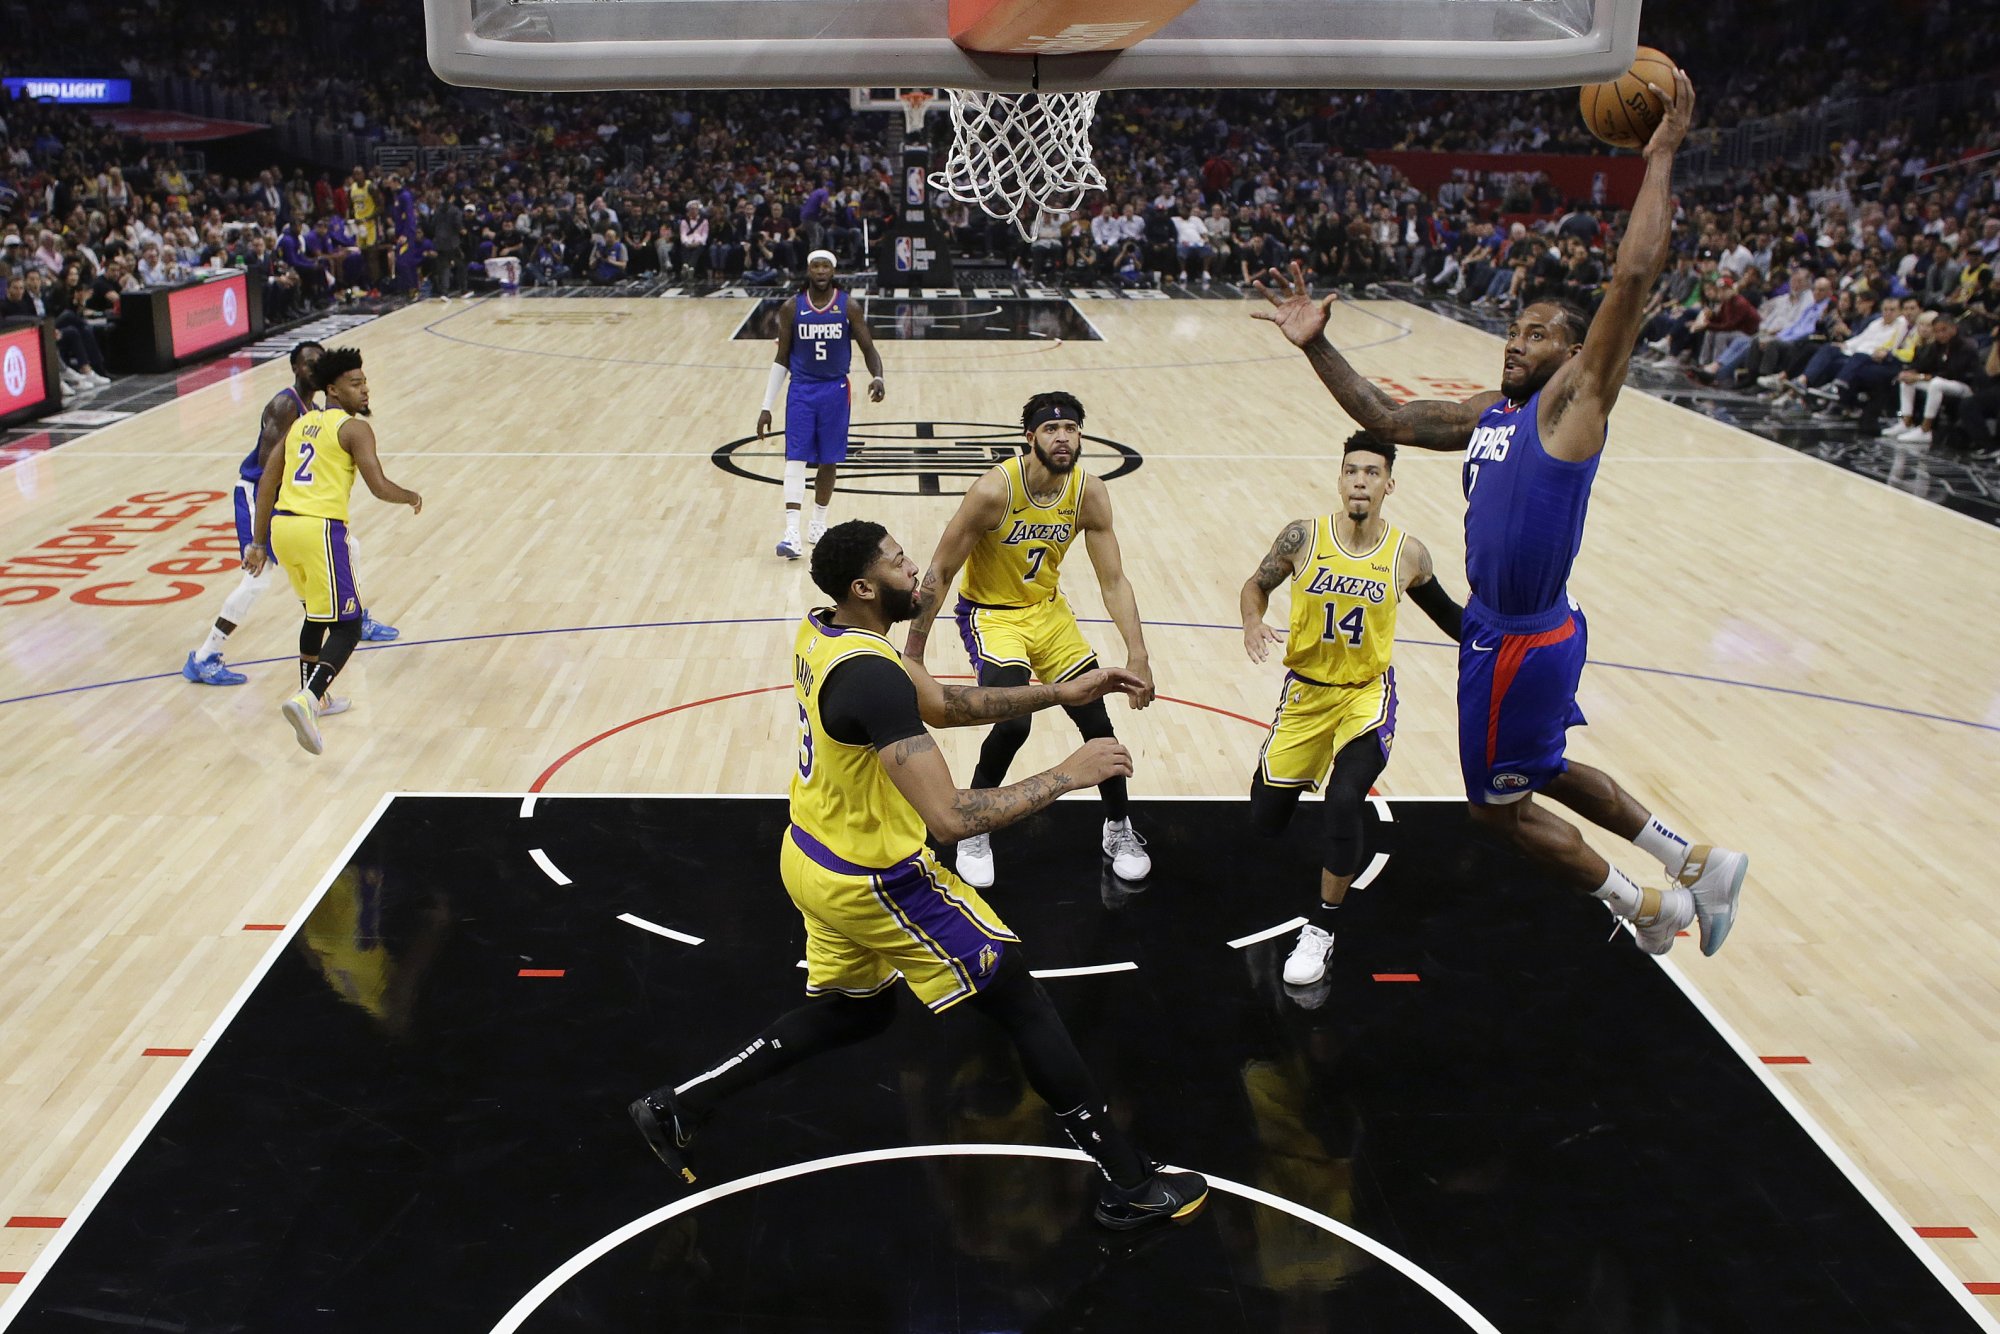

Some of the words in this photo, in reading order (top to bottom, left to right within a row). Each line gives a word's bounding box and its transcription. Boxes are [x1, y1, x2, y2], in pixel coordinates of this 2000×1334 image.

[26, 82, 60, 98] BUD
[61, 82, 105, 98] LIGHT
[798, 323, 842, 340] CLIPPERS
[815, 341, 827, 361] 5
[292, 442, 316, 486] 2
[1057, 508, 1076, 516] wish
[1000, 519, 1073, 546] LAKERS
[1022, 547, 1047, 585] 7
[1370, 562, 1390, 573] wish
[1304, 566, 1388, 604] LAKERS
[1321, 601, 1366, 649] 14
[795, 653, 815, 698] DAVIS
[797, 700, 816, 785] 3
